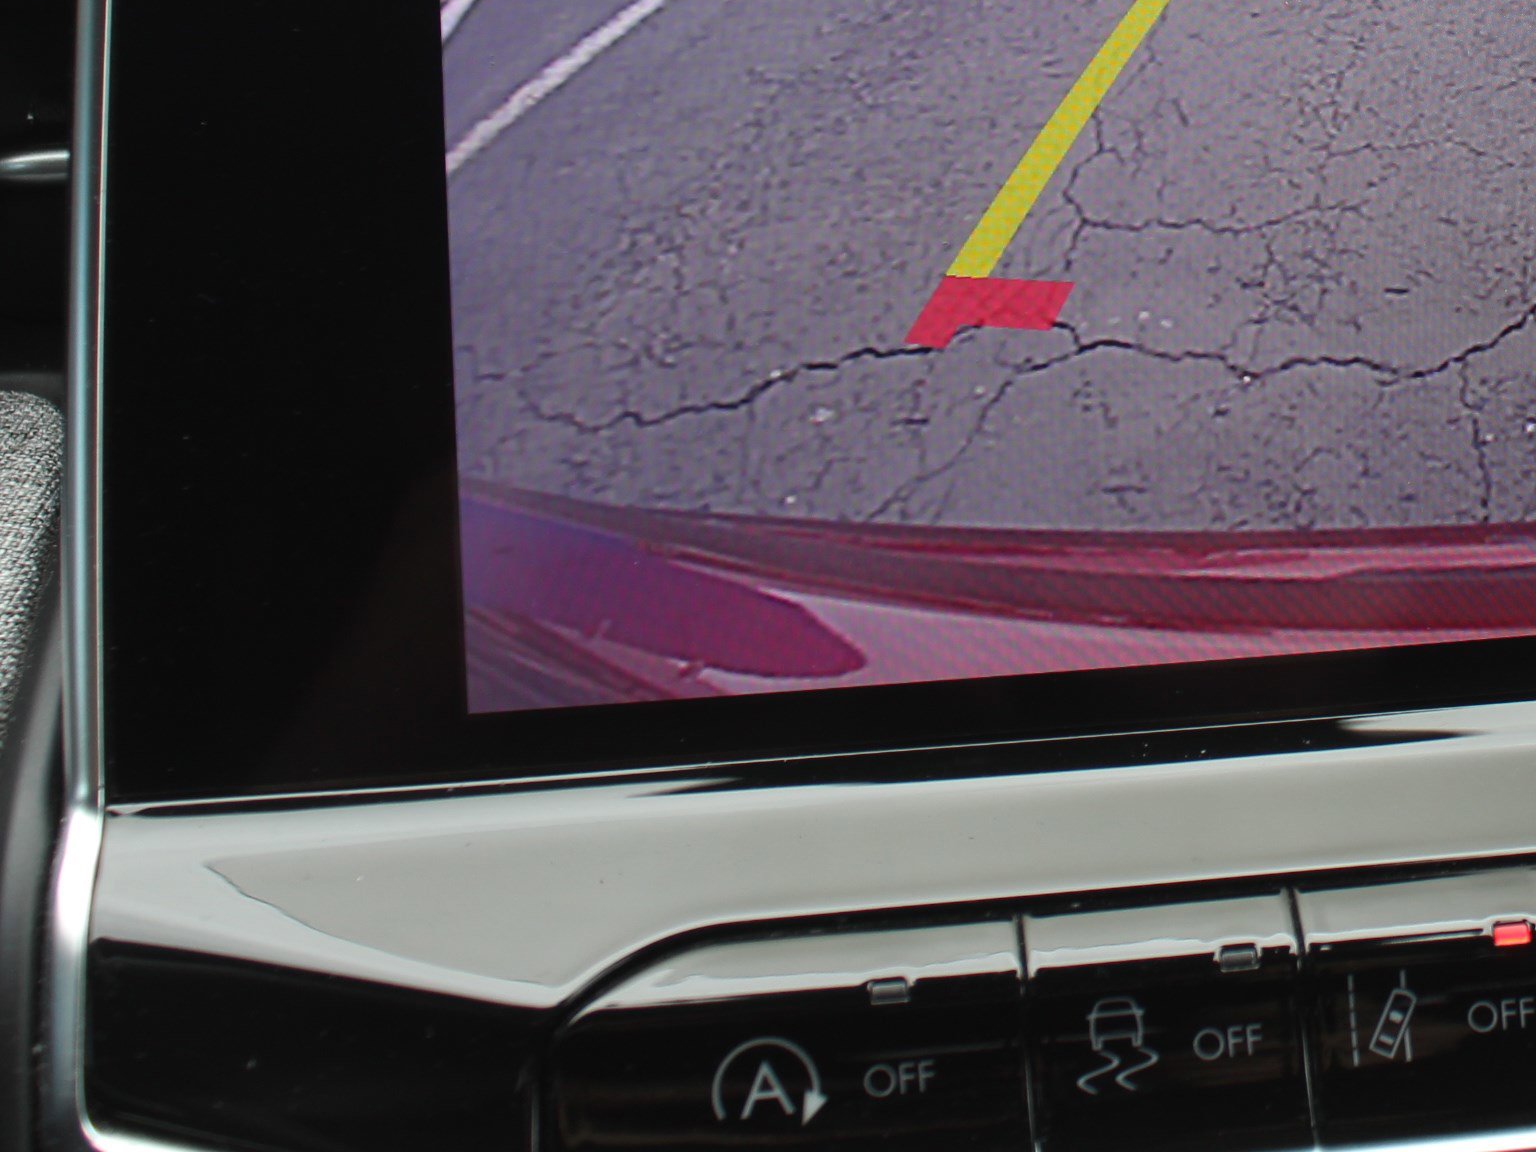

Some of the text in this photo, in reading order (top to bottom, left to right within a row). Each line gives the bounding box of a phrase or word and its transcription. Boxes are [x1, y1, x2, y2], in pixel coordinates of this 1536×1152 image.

[1467, 995, 1536, 1033] OFF
[1192, 1022, 1263, 1061] OFF
[740, 1058, 937, 1120] A OFF
